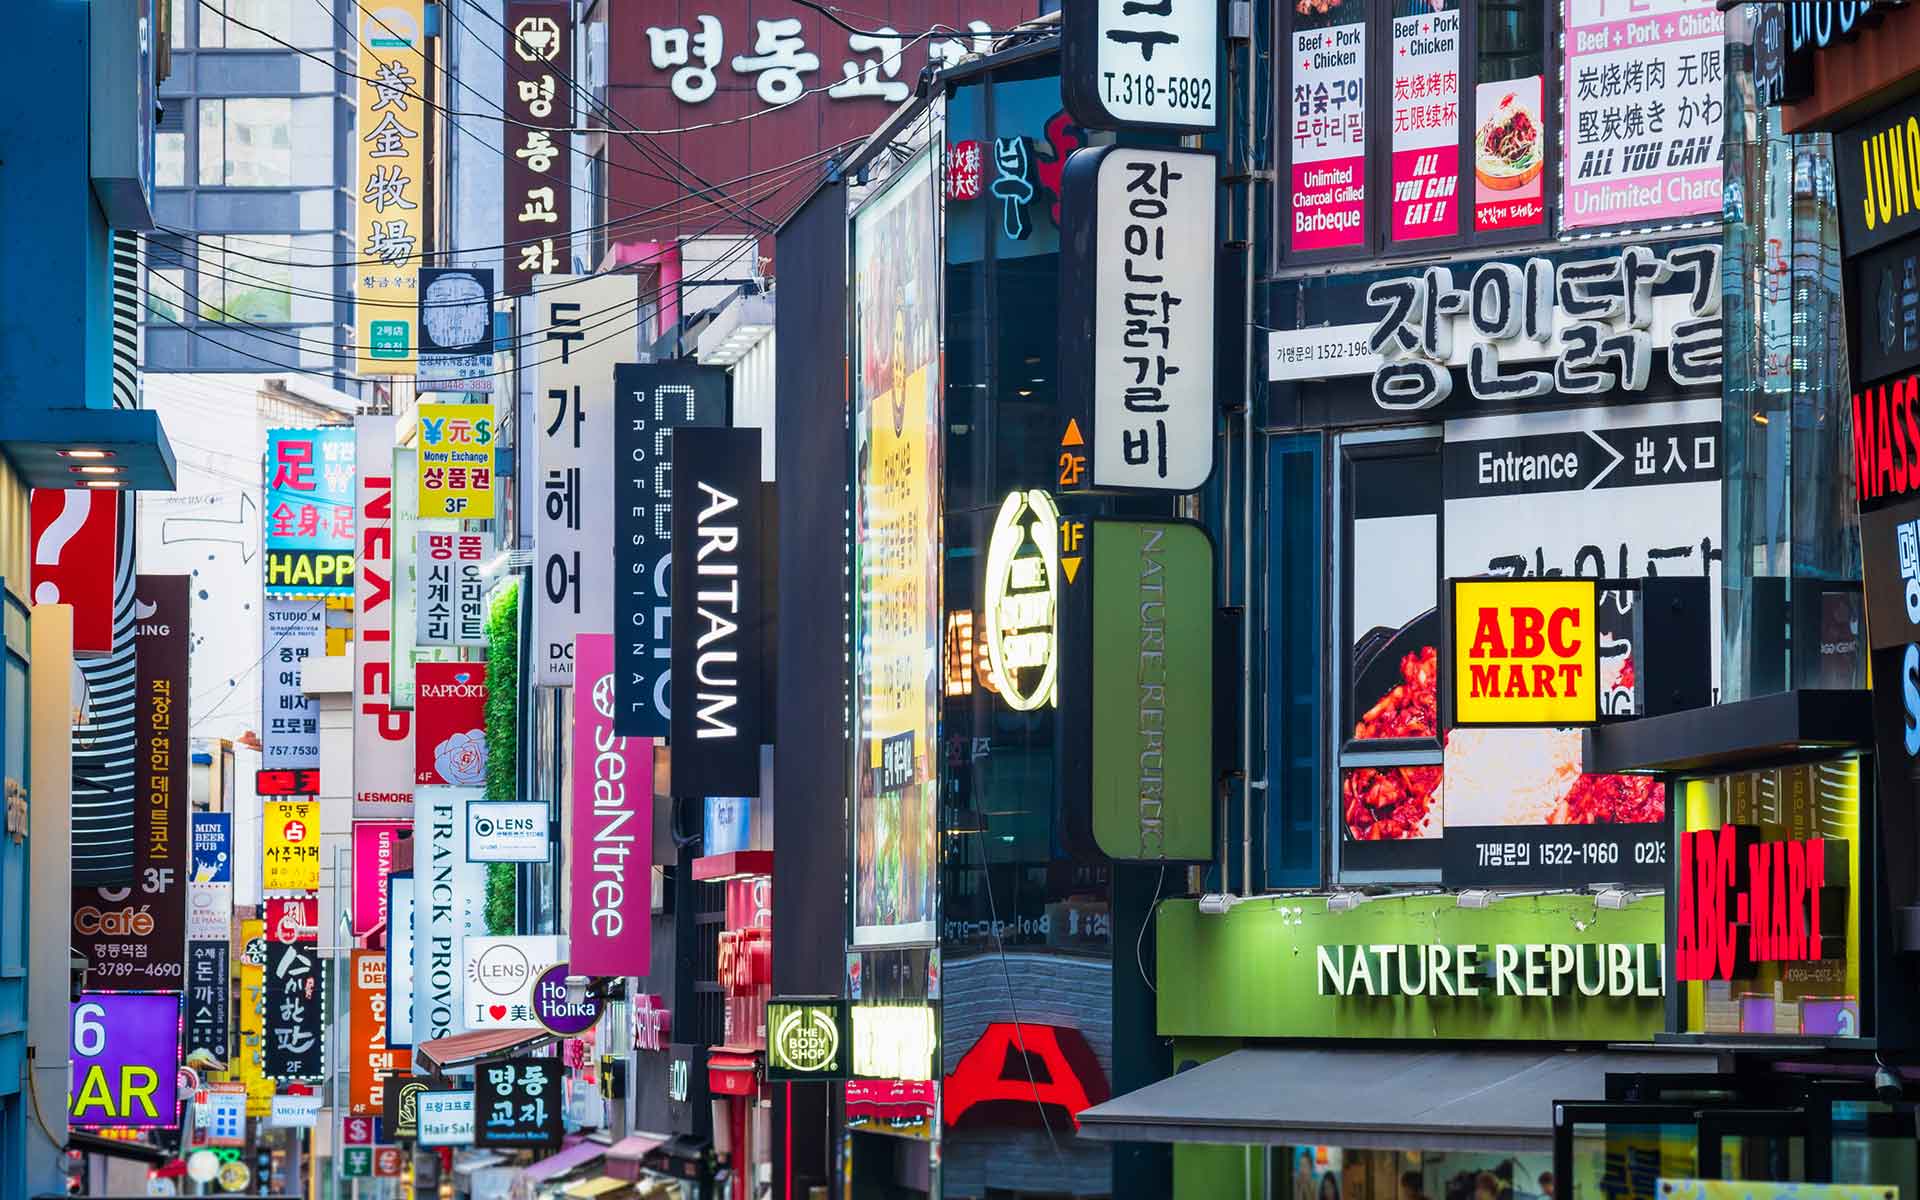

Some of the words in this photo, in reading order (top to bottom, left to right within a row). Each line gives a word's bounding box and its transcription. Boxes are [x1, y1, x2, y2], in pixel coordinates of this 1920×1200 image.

[1395, 20, 1419, 39] Beef
[1434, 15, 1459, 33] Pork
[1577, 29, 1609, 52] Beef
[1627, 20, 1660, 44] Pork
[1299, 35, 1322, 52] Beef
[1336, 30, 1361, 48] Pork
[1410, 36, 1454, 57] Chicken
[1313, 51, 1357, 70] Chicken
[1394, 70, 1457, 101] 炭烧烤肉
[1577, 59, 1666, 101] 炭烧烤肉
[1677, 50, 1722, 88] 无限
[1104, 71, 1212, 110] T.318-5892
[1294, 77, 1363, 117] 참숯구이
[1294, 112, 1363, 149] 무한리필
[1412, 154, 1439, 177] ALL
[1577, 148, 1614, 179] ALL
[1621, 141, 1663, 173] YOU
[1667, 135, 1713, 167] CAN
[514, 74, 561, 275] 명동교자
[1303, 166, 1353, 189] Unlimited
[1293, 188, 1333, 208] Charcoal
[1335, 184, 1364, 203] Grilled
[1394, 180, 1421, 202] YOU
[1425, 175, 1457, 198] CAN
[1574, 171, 1662, 214] Unlimited
[1295, 208, 1361, 233] Barbeque
[1404, 206, 1430, 225] EAT
[1122, 160, 1183, 478] 장인닭갈비
[1277, 346, 1314, 362] 가맹문의
[424, 451, 448, 463] Money
[451, 450, 489, 463] Exchange
[544, 302, 585, 613] 두가헤어
[1478, 450, 1579, 484] Entrance
[1634, 436, 1717, 475] 出入口
[424, 468, 490, 490] 상품권
[1059, 453, 1087, 485] 2F
[445, 498, 467, 513] 3F
[430, 535, 482, 560] 명품
[1060, 520, 1084, 552] 1F
[632, 391, 645, 712] PROFESSIONAL
[428, 565, 450, 640] 시계수리
[461, 565, 482, 639] 오리엔트
[696, 481, 739, 739] ARITAUM
[268, 612, 307, 621] STUDIO
[1469, 607, 1582, 658] ABC
[422, 684, 487, 697] RAPPORT
[1470, 664, 1583, 698] MART
[271, 718, 316, 734] 프로필
[269, 746, 318, 756] 757.7530
[418, 772, 432, 782] 4F
[358, 793, 413, 803] LESMORE
[150, 776, 169, 858] 데이트코스
[280, 805, 309, 818] 명동
[497, 819, 533, 830] LENS
[195, 824, 221, 832] MINI
[195, 834, 224, 842] BEER
[379, 832, 390, 876] URBAN
[432, 805, 452, 922] FRANCK
[1475, 843, 1531, 867] 가맹문의
[1539, 841, 1619, 865] 1522-1960
[142, 867, 175, 894] 3F
[74, 904, 155, 936] Café
[195, 948, 216, 960] 수제
[483, 964, 525, 977] LENS
[1317, 943, 1481, 997] NATURE
[194, 961, 214, 1023] 돈까스
[74, 1002, 106, 1057] 6
[797, 1028, 818, 1038] THE
[789, 1038, 826, 1049] BODY
[791, 1049, 825, 1060] SHOP
[286, 1061, 302, 1073] 2F
[68, 1064, 160, 1118] AR
[488, 1065, 548, 1096] 명동
[353, 1104, 367, 1113] 4F
[487, 1098, 549, 1129] 교자
[424, 1123, 449, 1135] Hair
